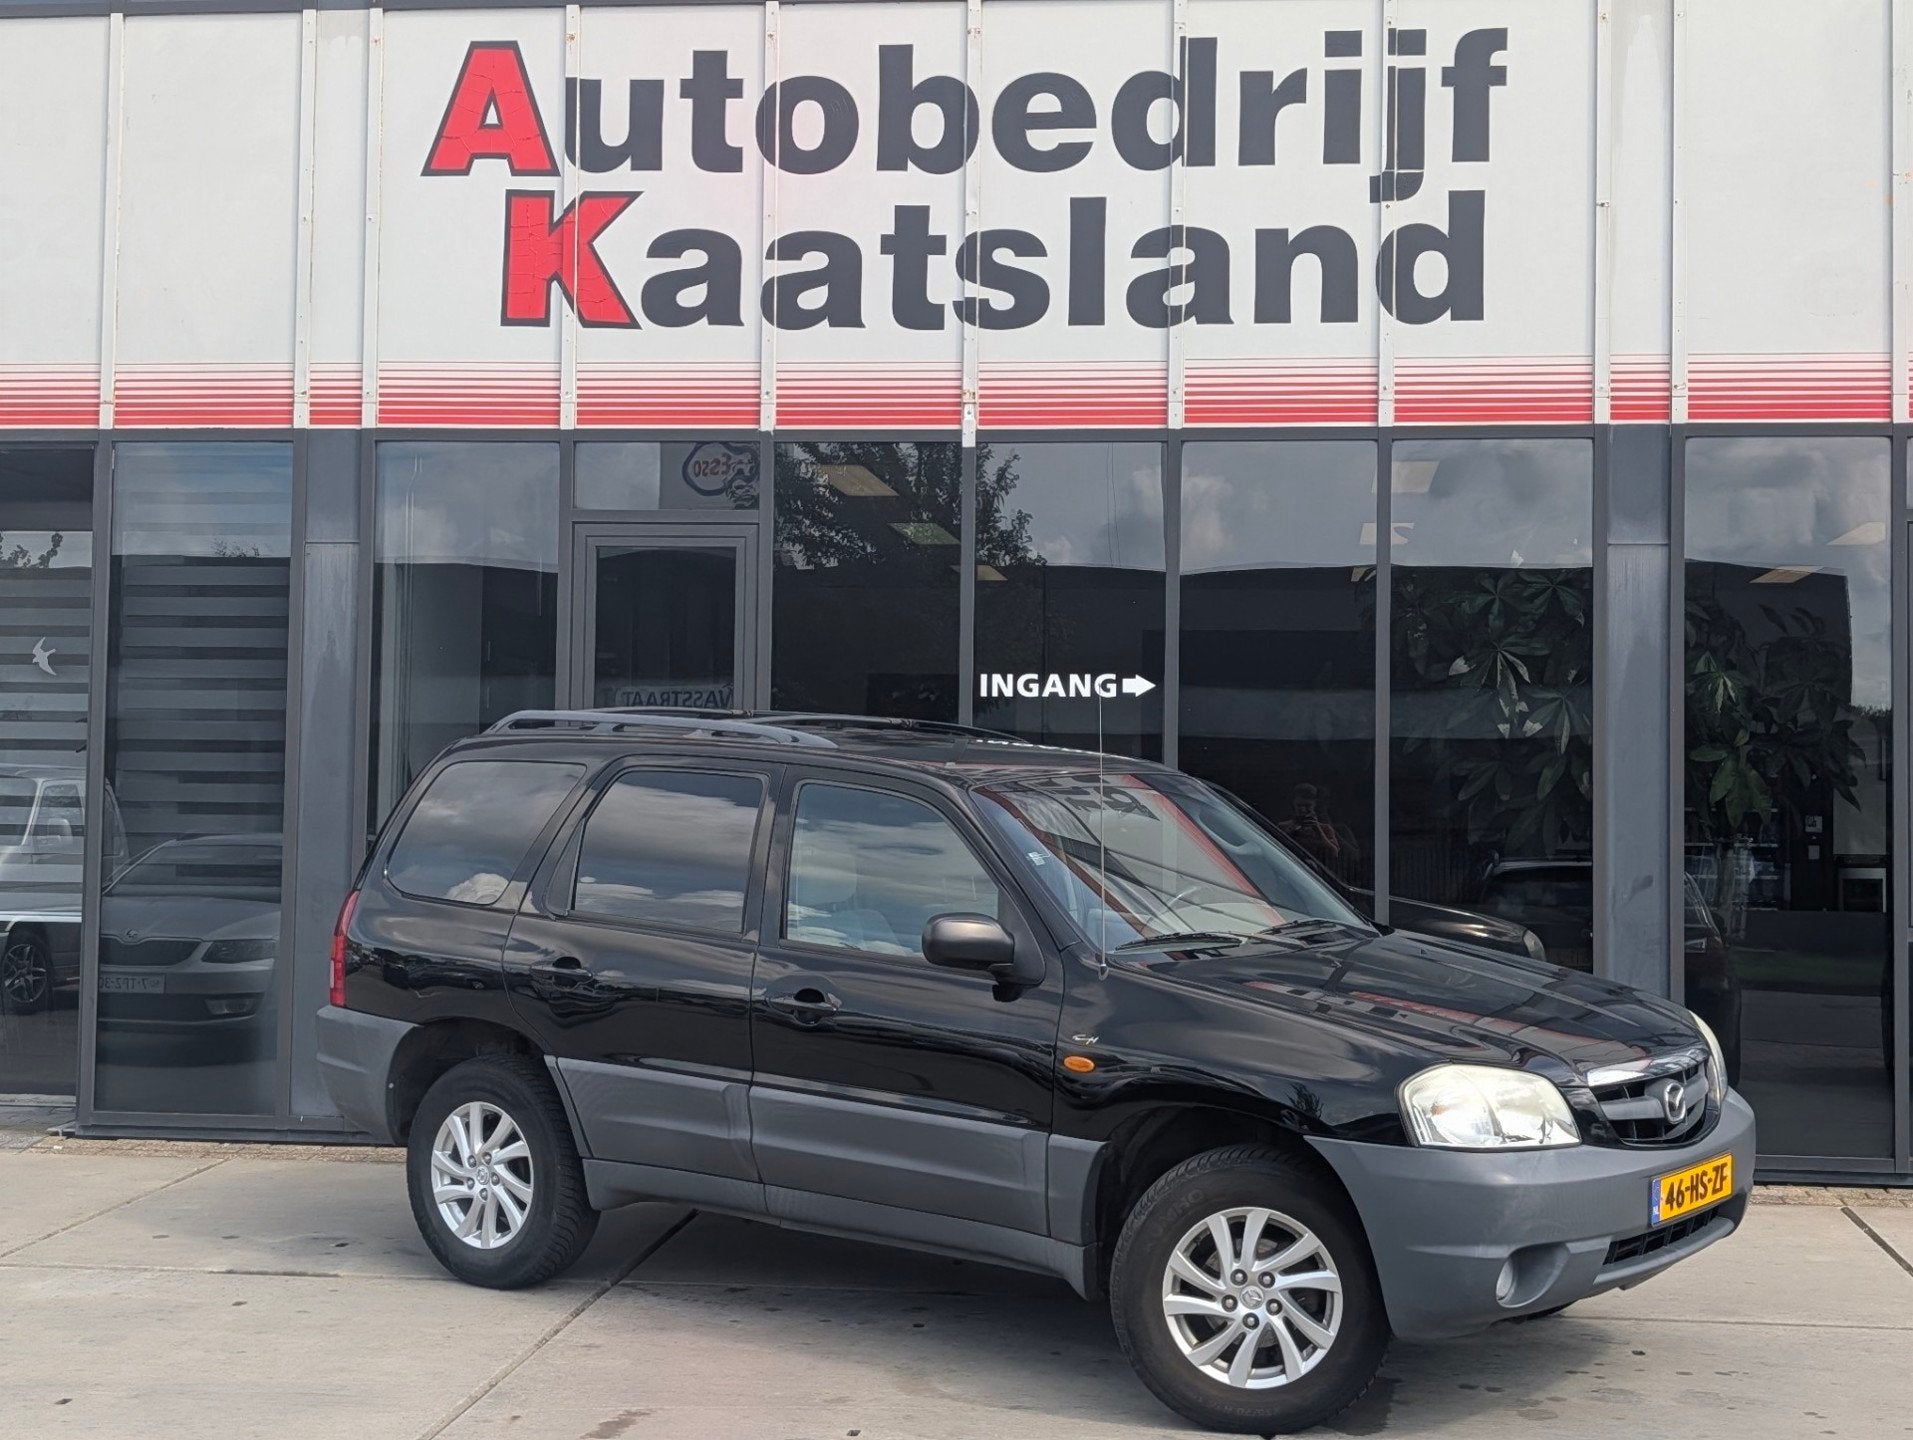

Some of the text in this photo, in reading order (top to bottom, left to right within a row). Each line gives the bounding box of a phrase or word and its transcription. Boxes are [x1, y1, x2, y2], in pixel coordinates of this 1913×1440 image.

[420, 27, 1509, 204] Autobedrijf
[501, 189, 1486, 331] Kaatsland
[980, 673, 1117, 698] INGANG
[1665, 1162, 1728, 1212] 46-HS-ZF
